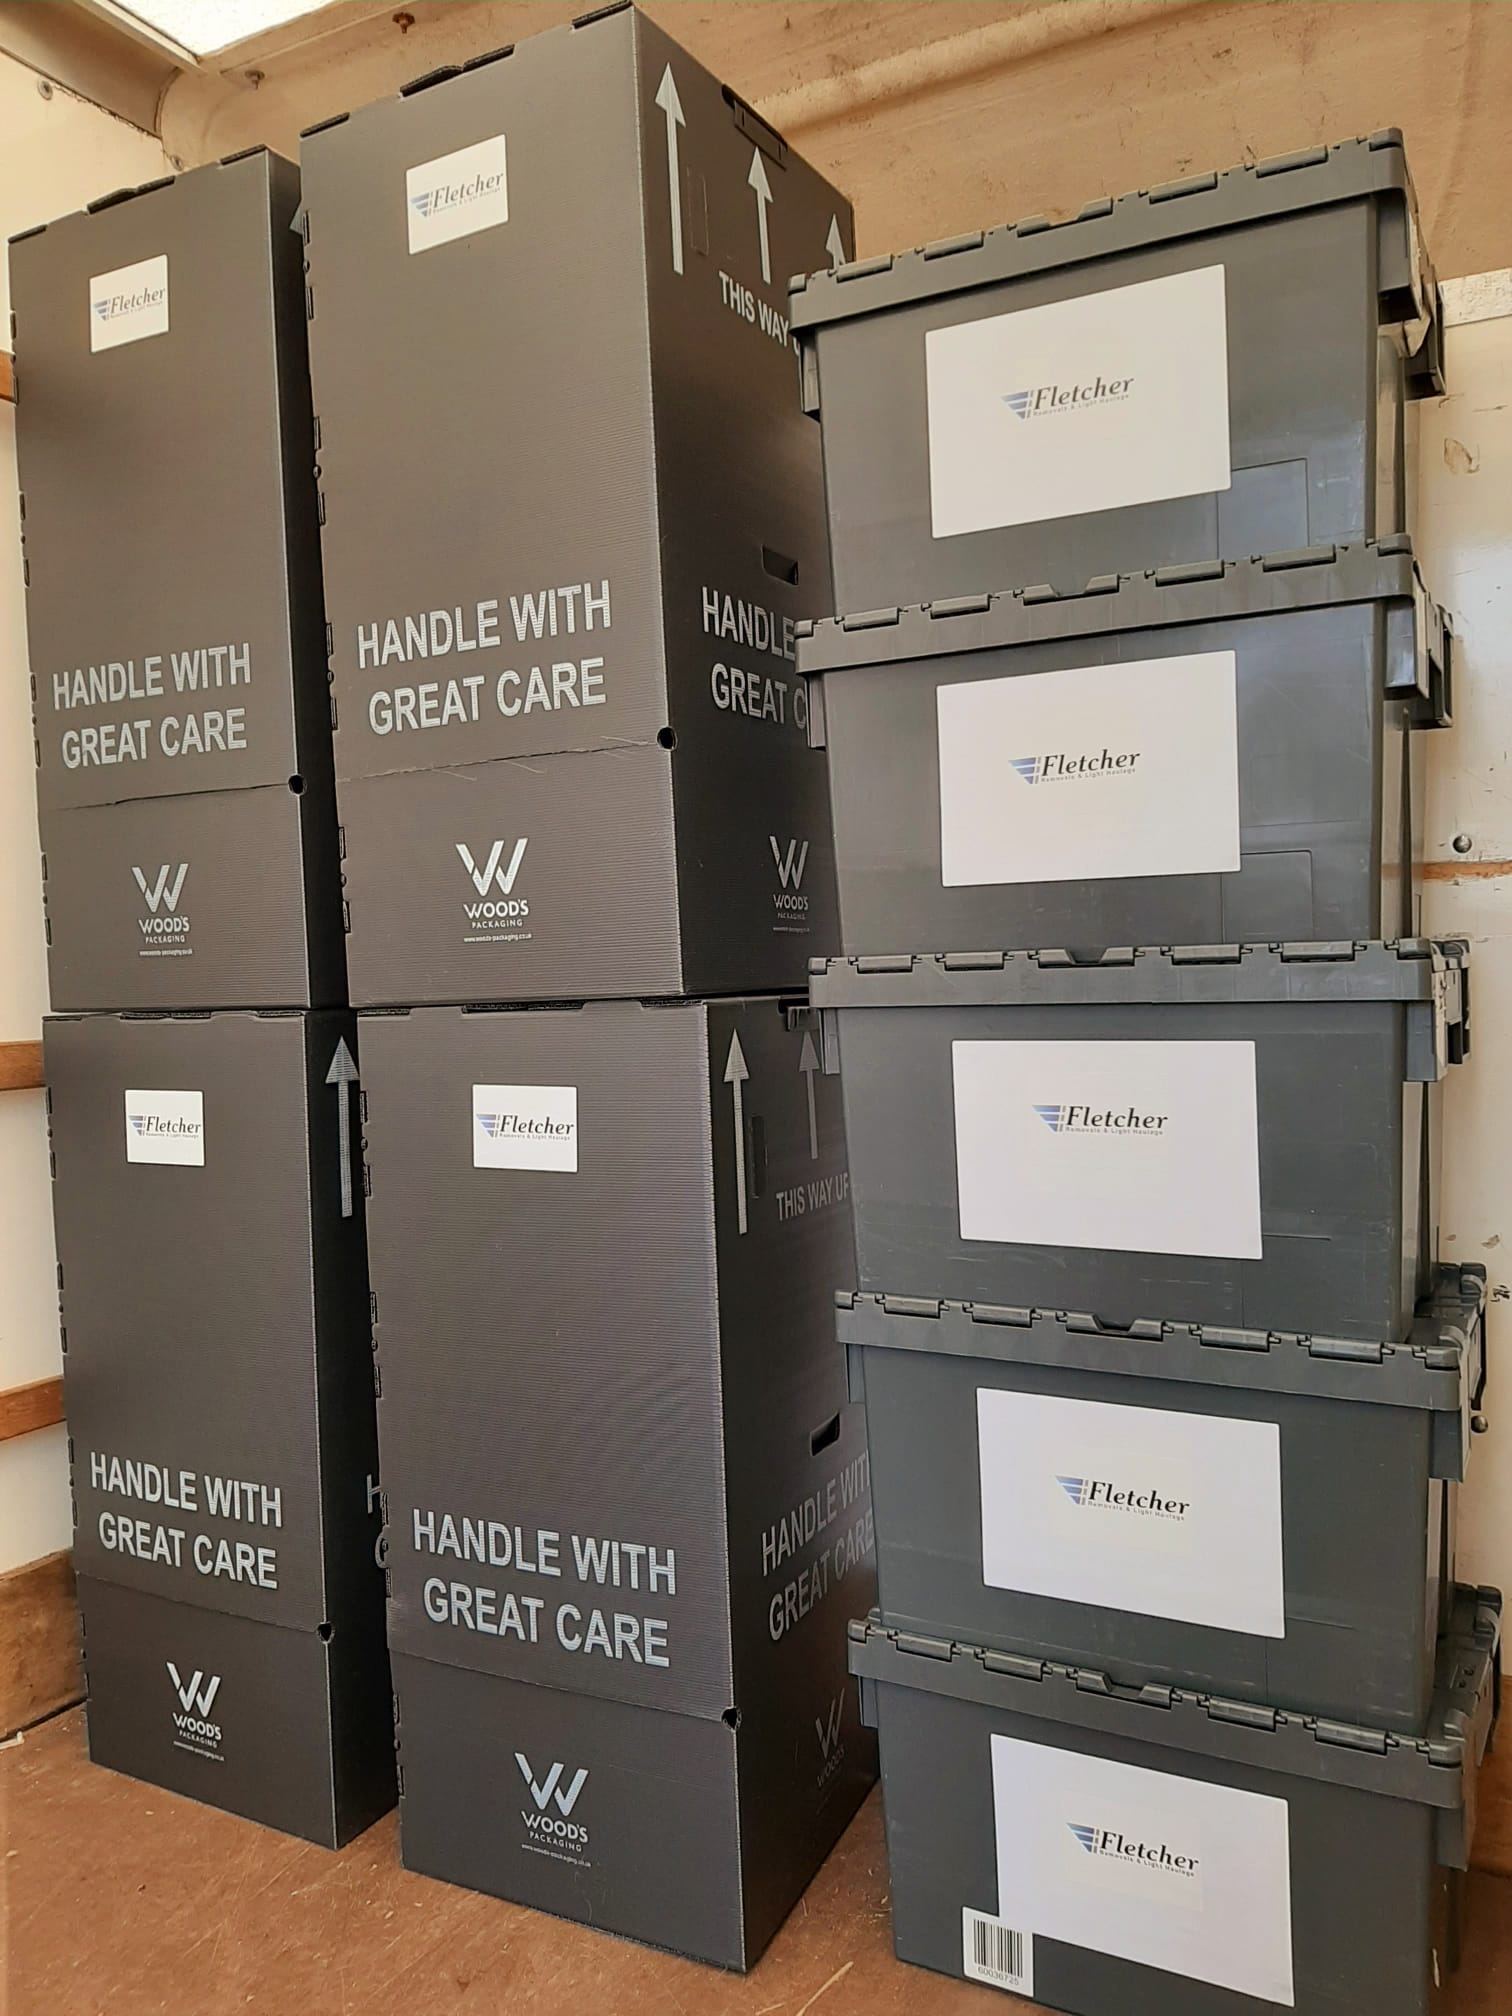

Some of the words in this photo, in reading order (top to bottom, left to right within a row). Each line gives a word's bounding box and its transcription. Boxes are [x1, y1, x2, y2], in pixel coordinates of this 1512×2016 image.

[433, 173, 504, 209] Fletcher
[111, 287, 166, 314] Fletcher
[718, 270, 756, 323] THIS
[757, 299, 789, 347] WAY
[1034, 376, 1135, 410] Fletcher
[357, 599, 501, 669] HANDLE
[509, 579, 612, 642] WITH
[702, 586, 796, 661] HANDLE
[52, 655, 164, 711] HANDLE
[170, 642, 252, 693] WITH
[368, 675, 485, 736] GREAT
[496, 656, 606, 717] CARE
[711, 663, 788, 724] GREAT
[61, 719, 152, 769] GREAT
[159, 707, 248, 757] CARE
[1041, 748, 1141, 777] Fletcher
[145, 934, 186, 944] PACKAGING
[471, 919, 524, 929] PACKAGING
[146, 1115, 202, 1134] Fletcher
[500, 1114, 575, 1135] Fletcher
[1066, 1105, 1169, 1129] Fletcher
[1066, 1126, 1101, 1134] Removals
[1111, 1128, 1131, 1136] Light
[775, 1186, 806, 1221] THIS
[807, 1176, 833, 1211] WAY
[90, 1451, 198, 1511] HANDLE
[203, 1475, 282, 1528] WITH
[1088, 1480, 1191, 1514] Fletcher
[762, 1478, 838, 1576] HANDLE
[98, 1512, 186, 1568] GREAT
[193, 1534, 279, 1589] CARE
[412, 1507, 562, 1577] HANDLE
[570, 1534, 677, 1596] WITH
[768, 1548, 831, 1642] GREAT
[423, 1577, 545, 1643] GREAT
[556, 1603, 671, 1668] CARE
[179, 1729, 218, 1749] PACKAGING
[529, 1830, 582, 1853] PACKAGING
[1100, 1830, 1200, 1870] Fletcher
